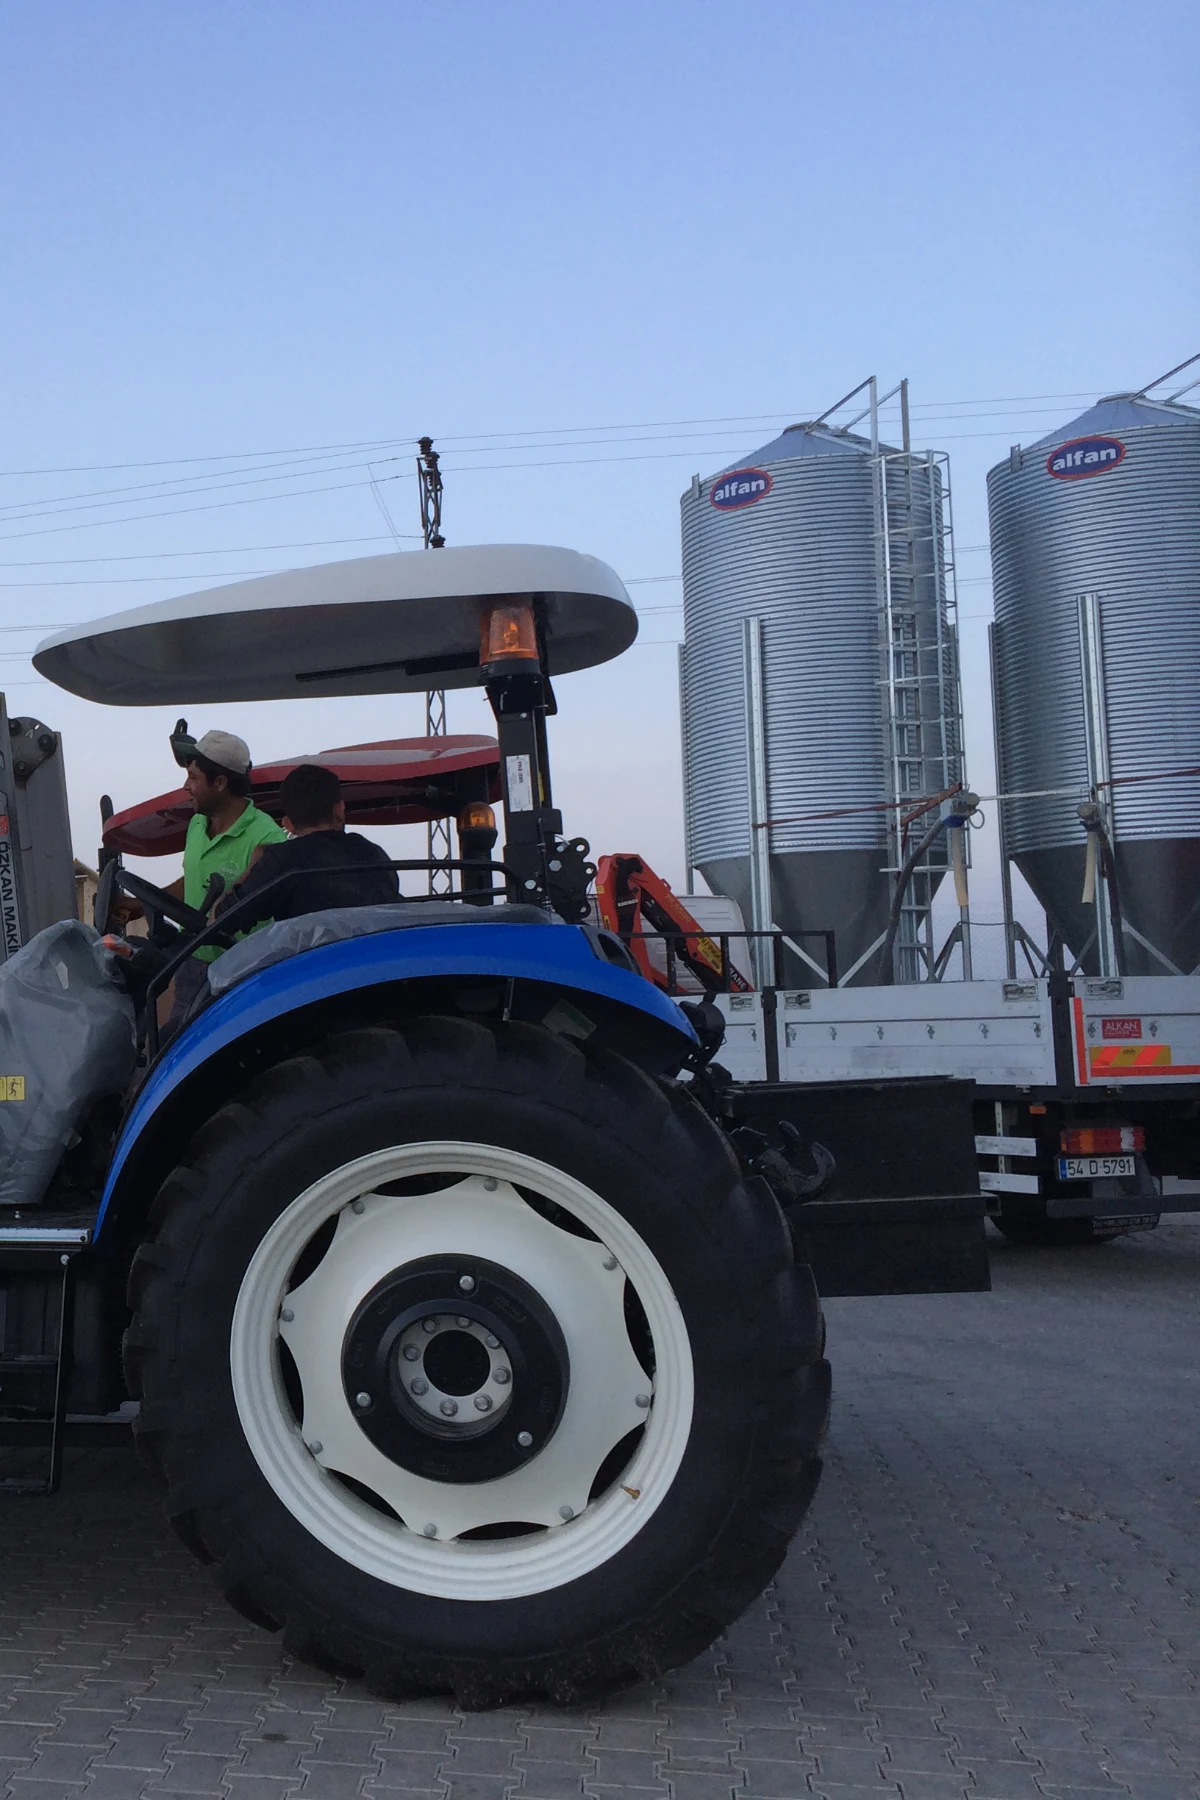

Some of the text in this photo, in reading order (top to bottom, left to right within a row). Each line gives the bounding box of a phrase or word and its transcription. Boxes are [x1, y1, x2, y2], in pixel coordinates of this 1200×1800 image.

[1052, 447, 1117, 471] alfan
[714, 479, 765, 502] alfan
[1105, 1021, 1138, 1030] ALKAN
[1067, 1159, 1131, 1176] 54 D 5791
